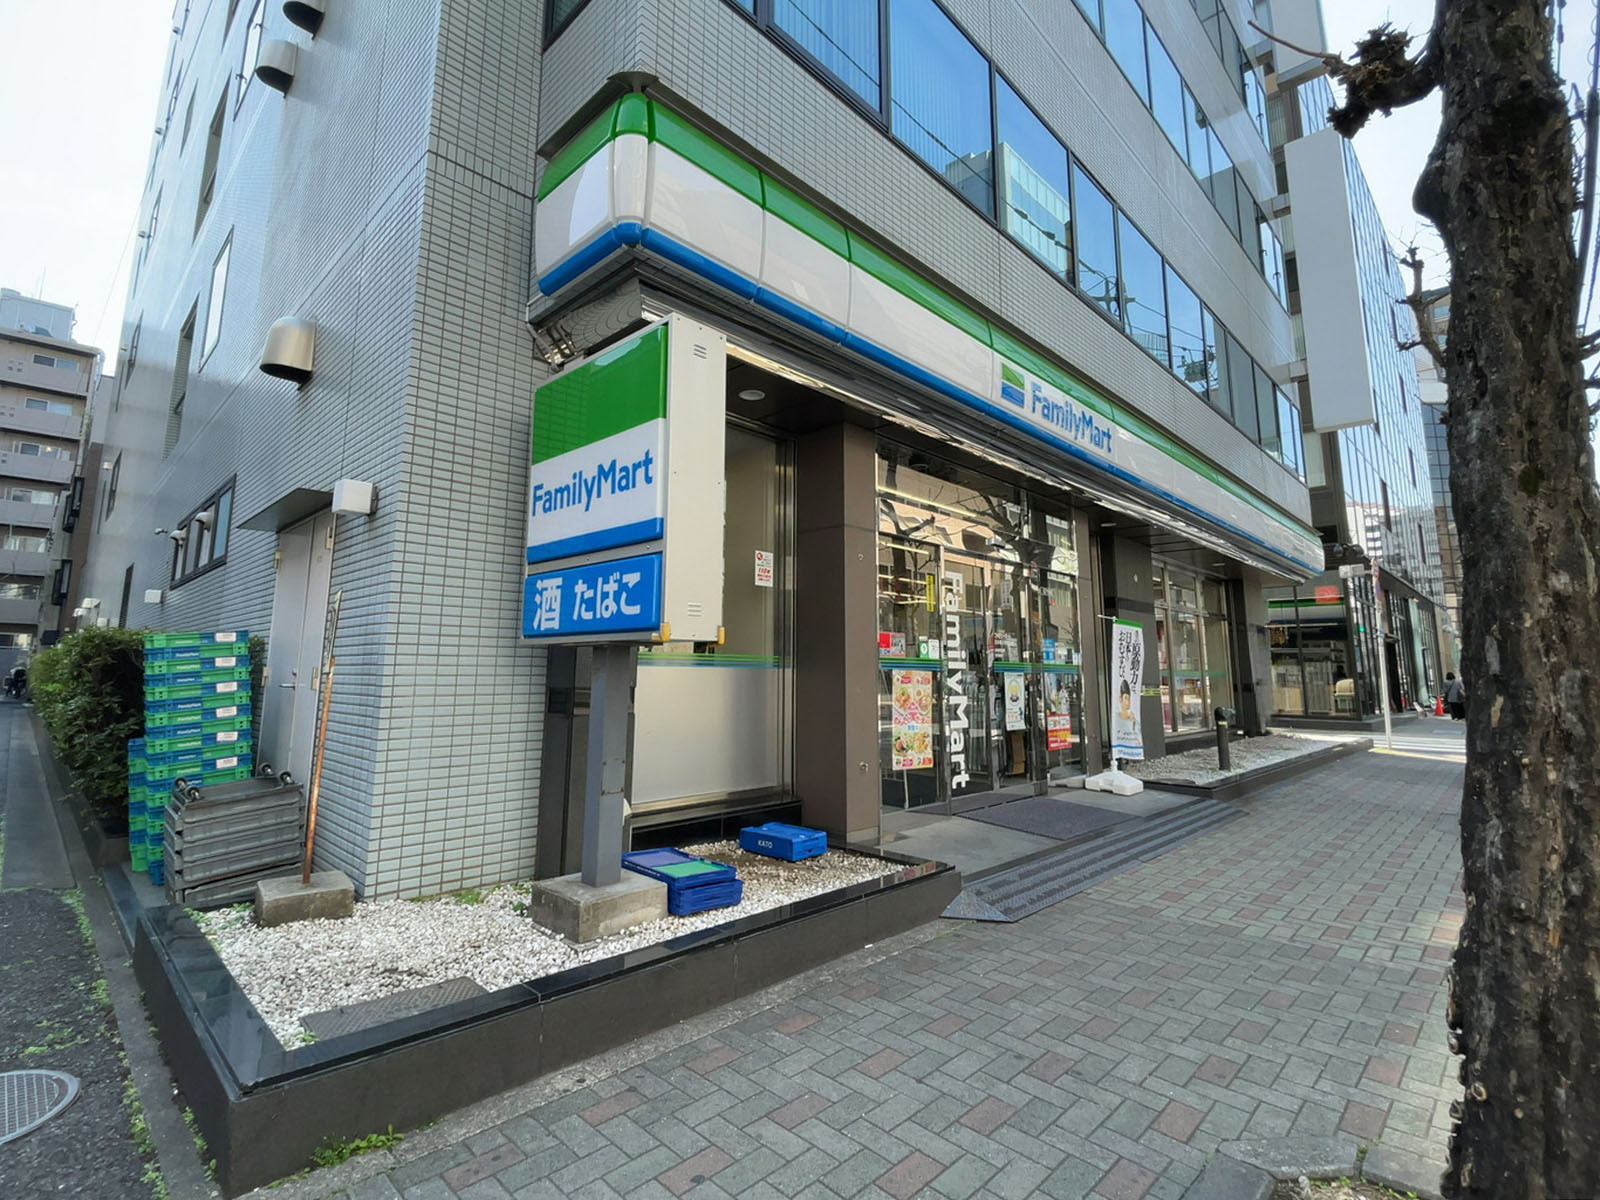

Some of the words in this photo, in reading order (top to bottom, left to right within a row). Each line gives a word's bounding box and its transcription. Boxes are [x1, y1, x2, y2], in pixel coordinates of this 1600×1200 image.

[1030, 381, 1112, 453] FamilyMart
[532, 448, 654, 517] FamilyMart
[533, 576, 563, 632] 酒
[572, 571, 641, 621] たばこ
[944, 571, 971, 790] FamilyMart
[758, 840, 773, 849] KATO
